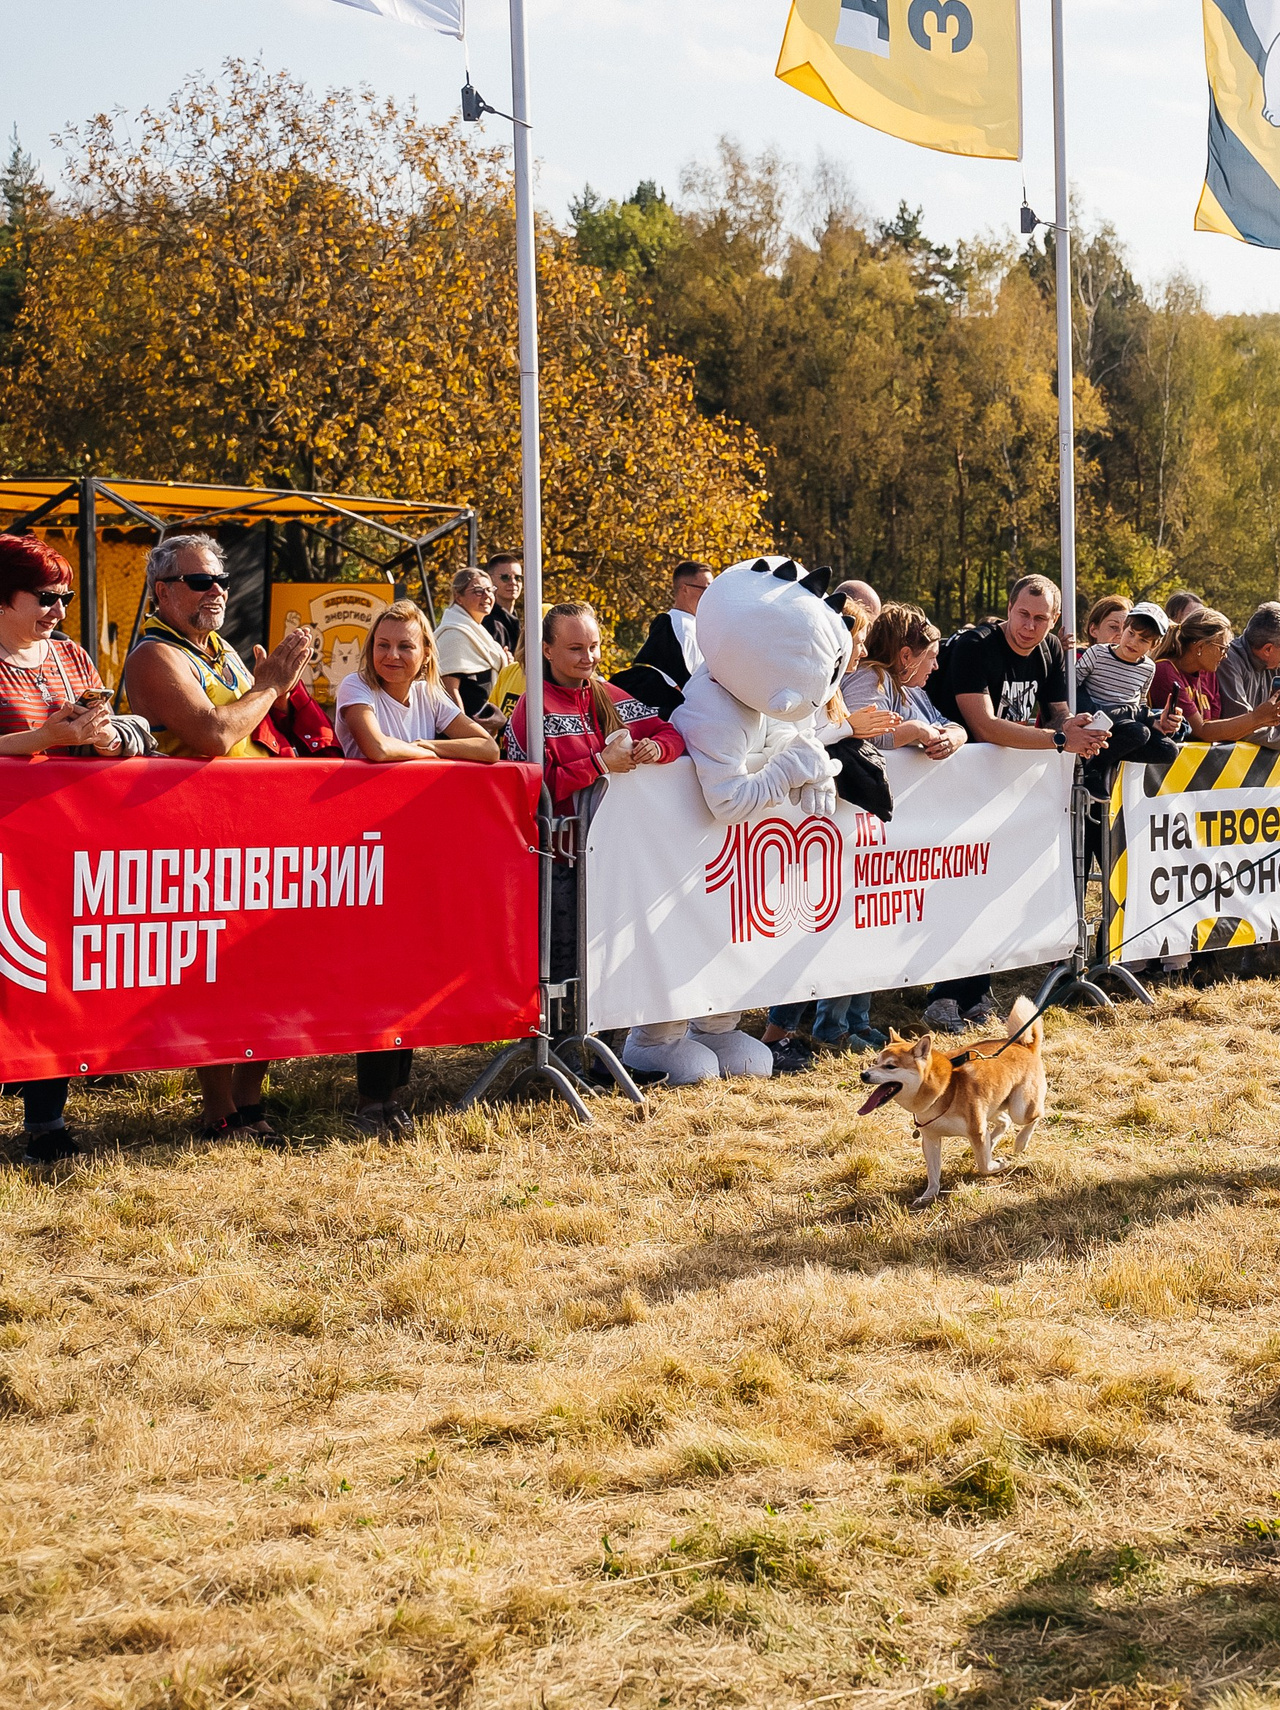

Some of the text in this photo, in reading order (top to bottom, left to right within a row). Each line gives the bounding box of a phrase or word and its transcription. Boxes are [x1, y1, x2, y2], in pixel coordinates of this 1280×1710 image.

[324, 610, 372, 624] энергией
[1150, 812, 1192, 852] на
[72, 831, 385, 917] МОСКОВСКИЙ
[705, 815, 844, 944] 100
[854, 842, 991, 888] МОСКОВСКОМУ
[854, 887, 925, 929] СПОРТУ
[72, 919, 226, 993] СПОРТ
